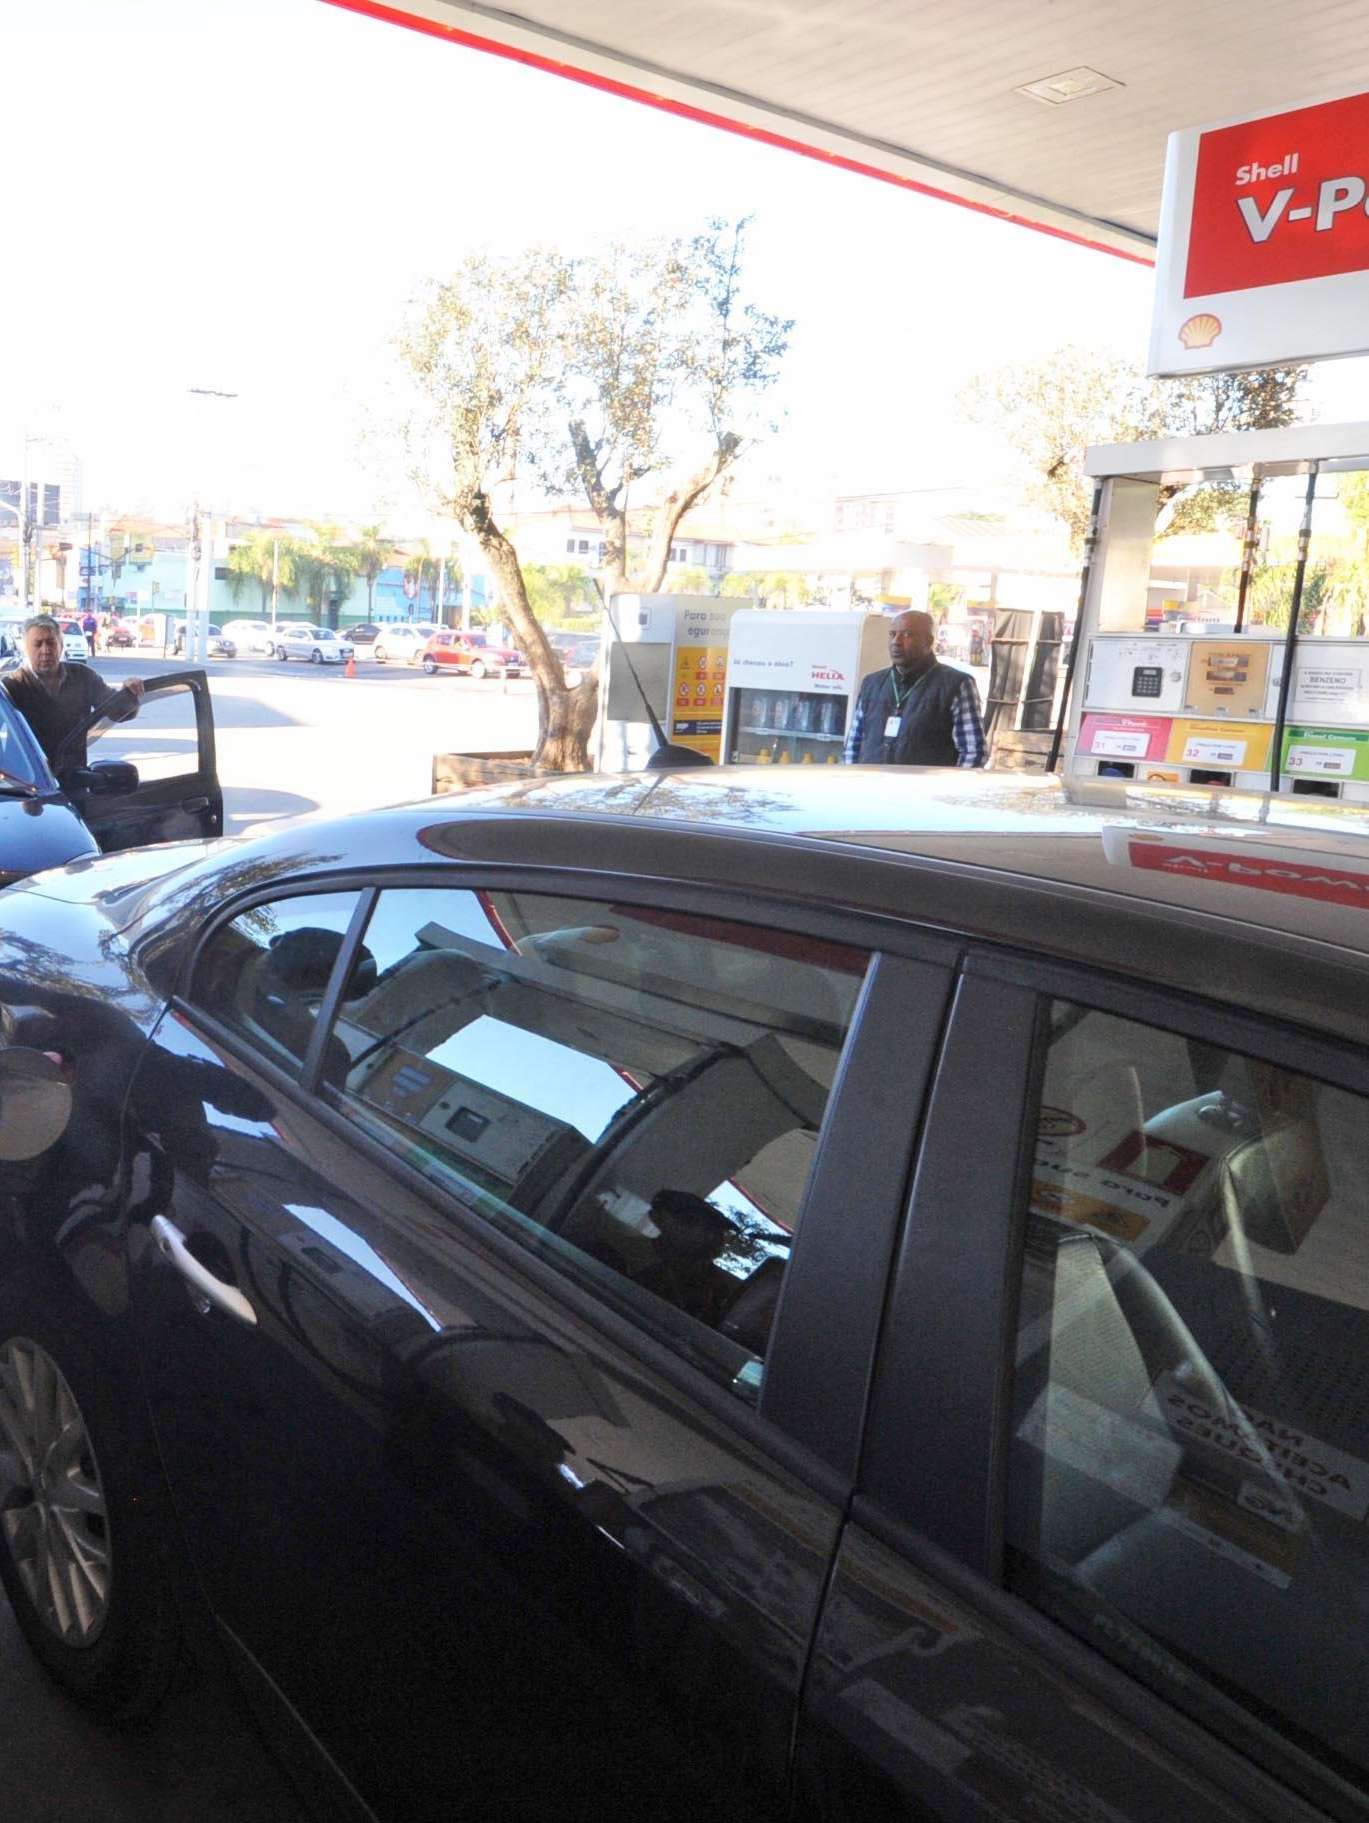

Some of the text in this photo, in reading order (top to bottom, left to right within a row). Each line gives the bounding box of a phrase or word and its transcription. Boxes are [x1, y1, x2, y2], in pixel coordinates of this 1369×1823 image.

[1235, 152, 1299, 186] Shell
[1236, 176, 1369, 243] V-P
[812, 671, 845, 681] HELIX
[1186, 748, 1199, 758] 32
[1288, 756, 1303, 766] 33
